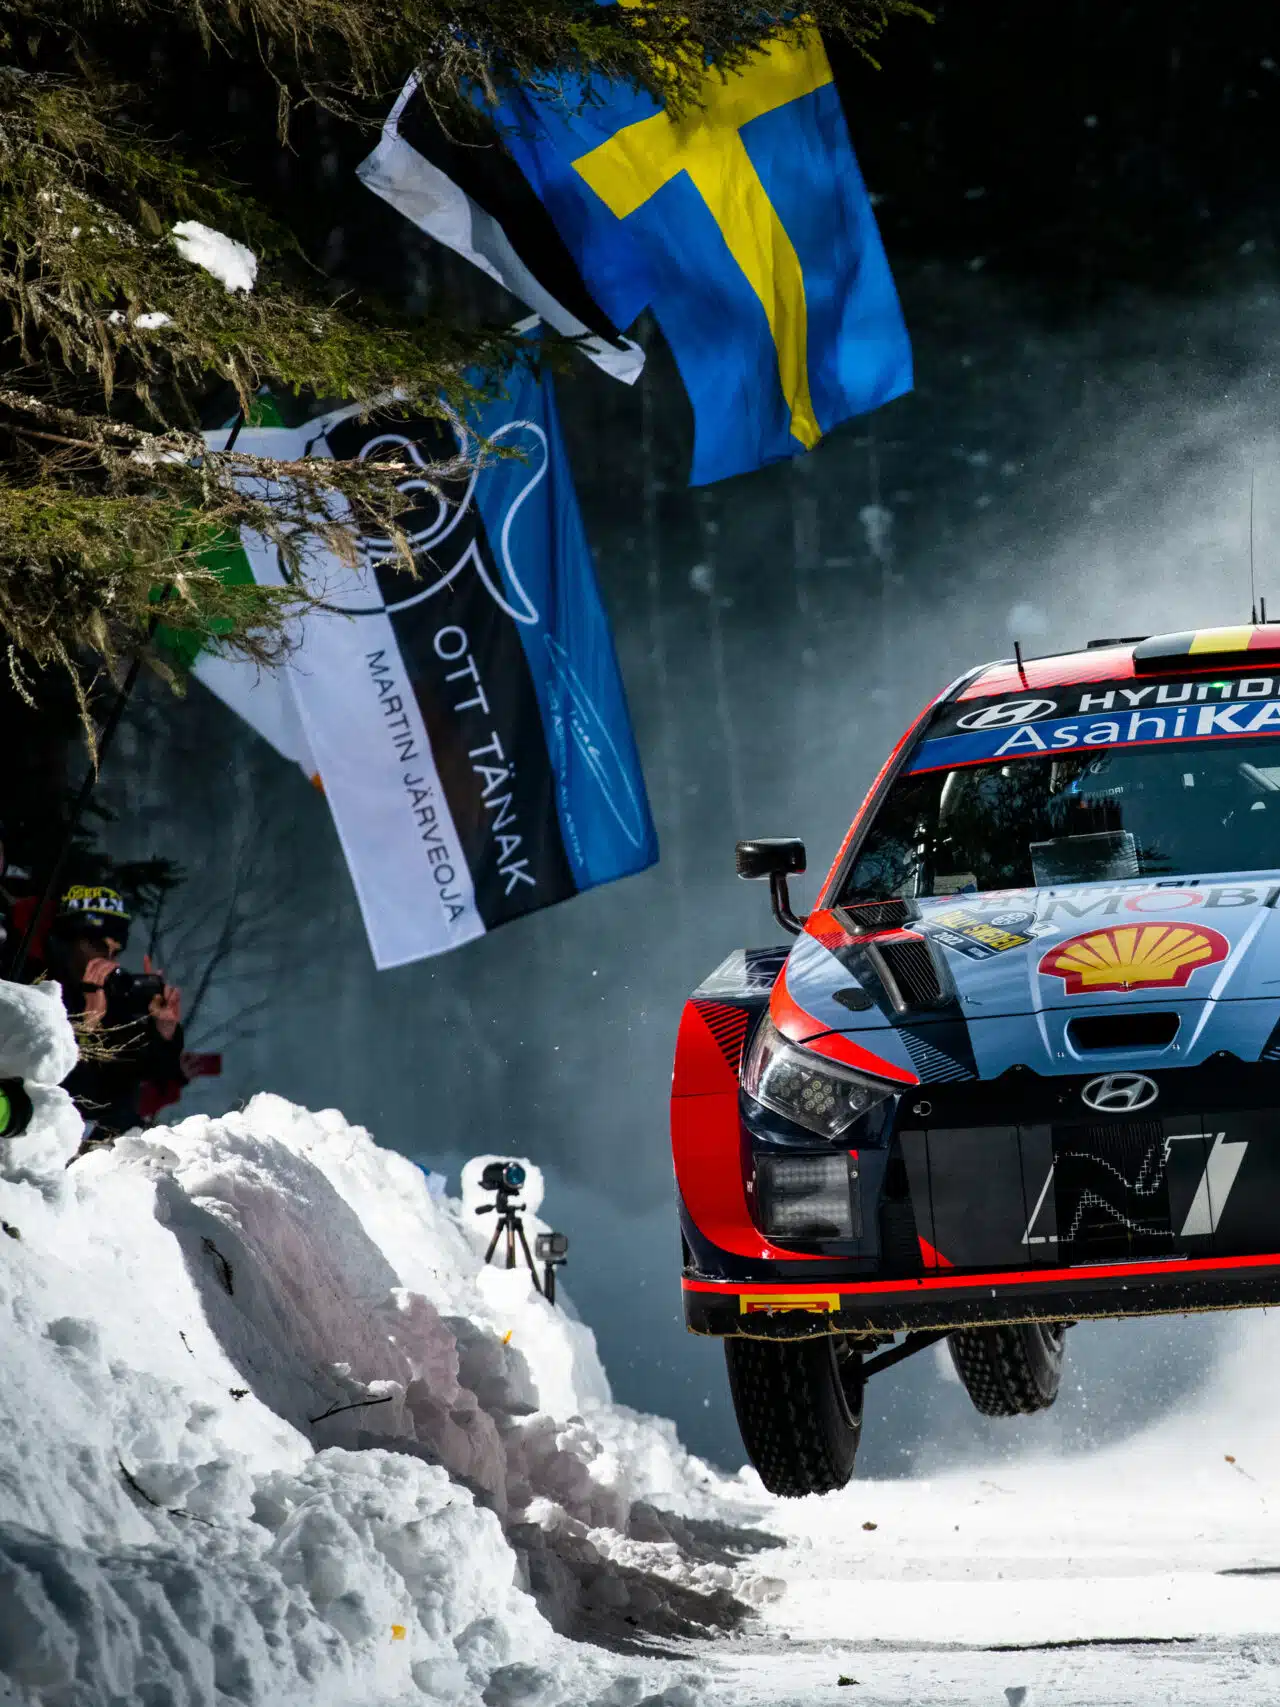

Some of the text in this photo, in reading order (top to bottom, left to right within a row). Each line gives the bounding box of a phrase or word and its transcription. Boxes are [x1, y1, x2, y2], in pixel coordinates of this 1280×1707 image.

[366, 649, 465, 924] MARTIN JÄRVEOJA
[434, 625, 536, 896] OTT TÄNAK
